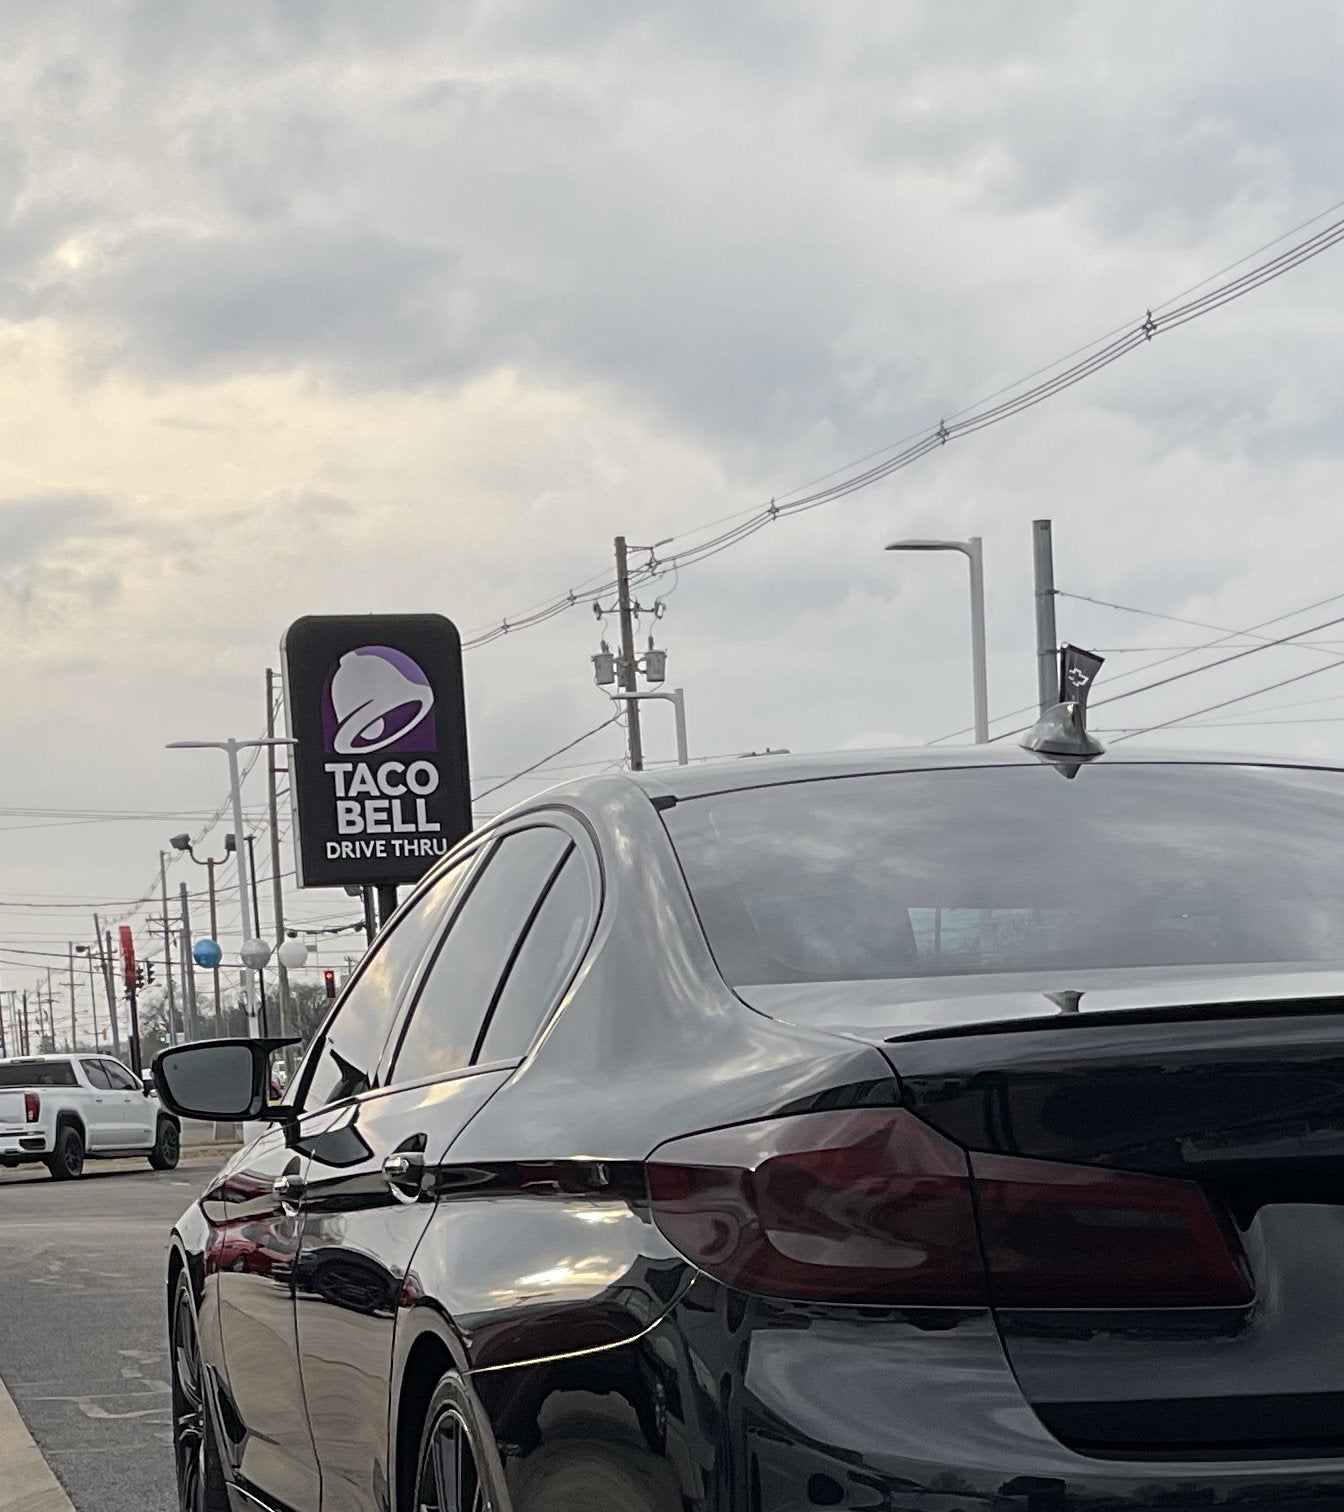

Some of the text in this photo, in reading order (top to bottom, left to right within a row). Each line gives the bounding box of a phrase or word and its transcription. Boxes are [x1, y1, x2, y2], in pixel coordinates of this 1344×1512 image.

[324, 760, 439, 798] TACO
[337, 798, 441, 835] BELL
[326, 838, 448, 859] DRIVE THRU
